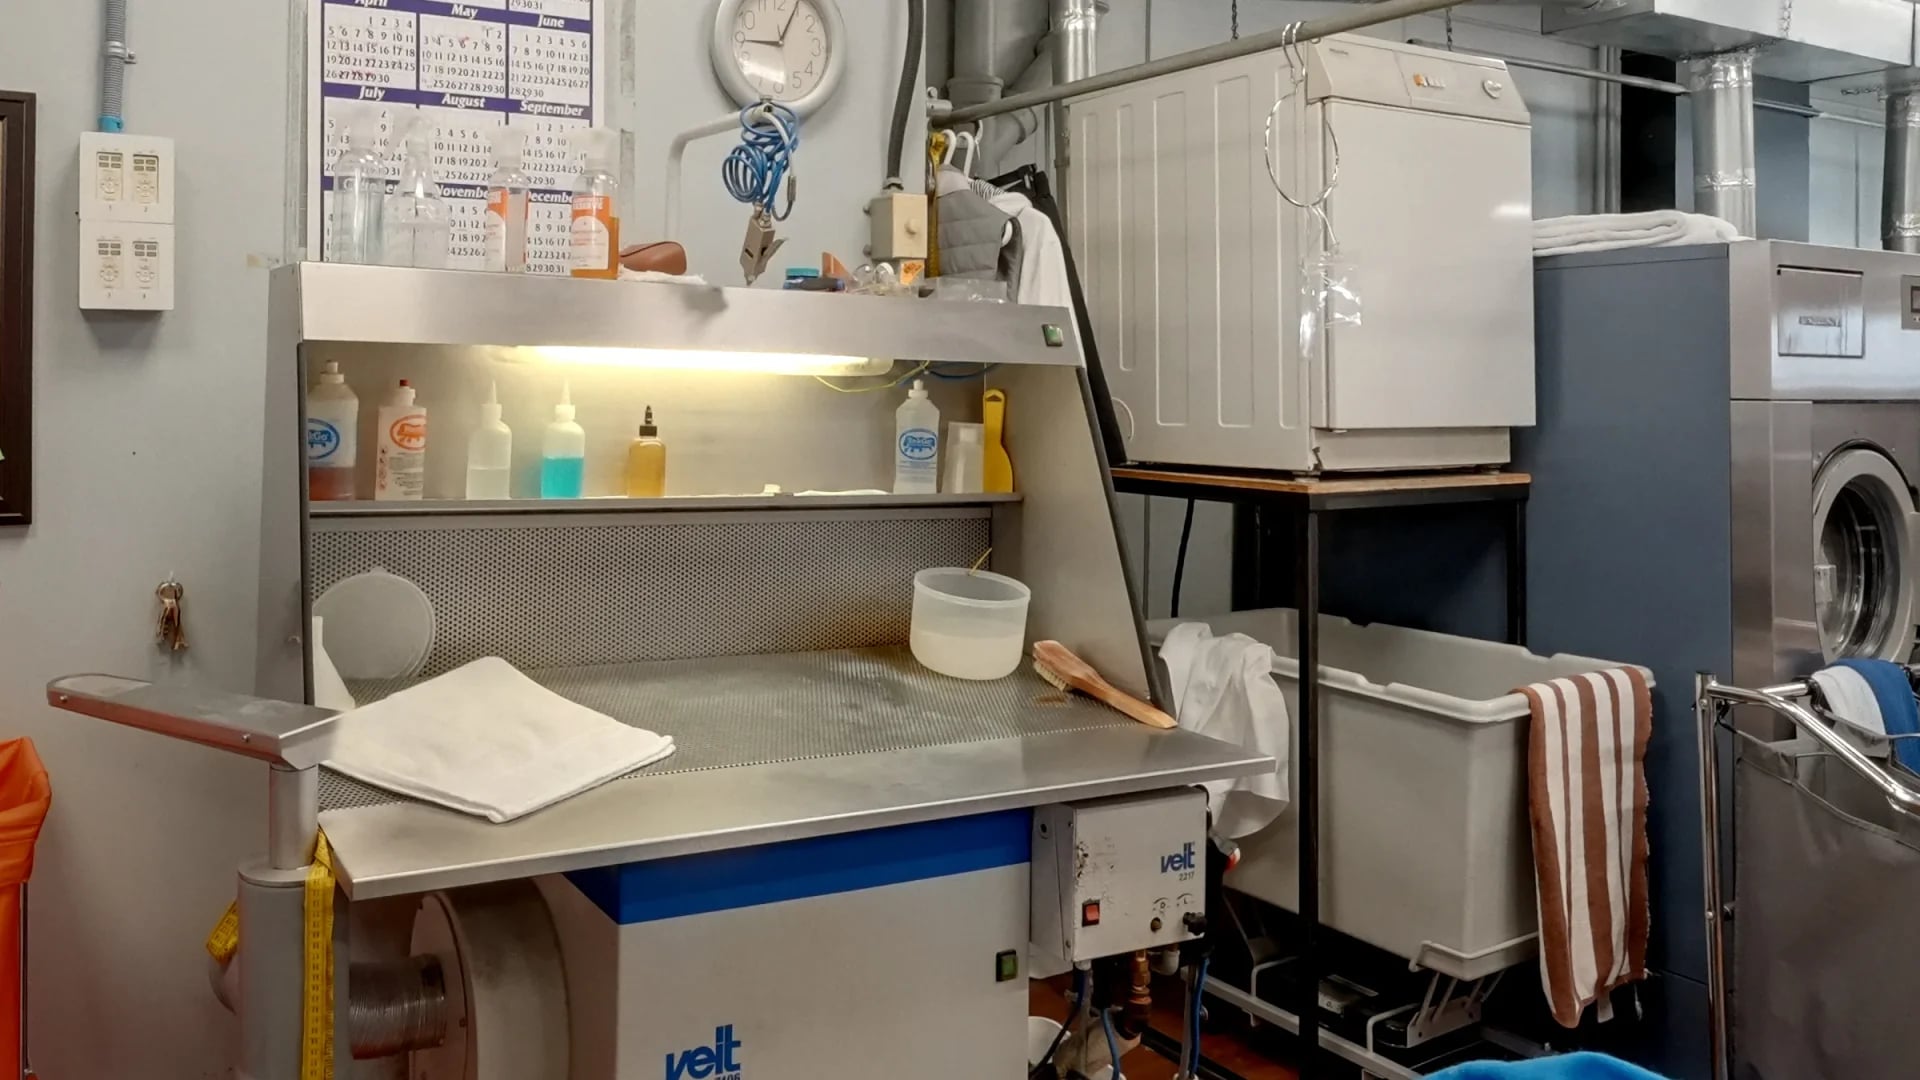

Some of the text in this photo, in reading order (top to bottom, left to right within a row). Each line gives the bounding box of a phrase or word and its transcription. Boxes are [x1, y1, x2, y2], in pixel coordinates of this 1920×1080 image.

[451, 4, 479, 19] May
[381, 17, 386, 26] 2
[395, 19, 399, 28] 3
[407, 20, 412, 28] 4
[537, 14, 565, 28] June
[739, 10, 755, 30] 10
[805, 15, 815, 33] 2
[329, 26, 335, 35] 5
[341, 27, 348, 36] 6
[355, 28, 360, 37] 7
[381, 31, 387, 40] 9
[393, 32, 402, 42] 10
[406, 35, 413, 43] 11
[497, 30, 502, 39] 2
[735, 31, 745, 48] 9
[327, 41, 415, 57] 12 14 15 16 17 18
[424, 36, 429, 44] 3
[449, 39, 454, 47] 5
[473, 42, 478, 50] 7
[536, 35, 541, 43] 2
[547, 36, 553, 45] 3
[570, 39, 576, 48] 5
[581, 41, 587, 49] 6
[811, 38, 821, 57] 3
[435, 52, 442, 60] 11
[447, 53, 456, 61] 12
[459, 54, 468, 63] 13
[471, 56, 480, 64] 14
[483, 57, 493, 65] 15
[496, 58, 504, 66] 16
[513, 46, 518, 55] 7
[524, 47, 530, 56] 8
[546, 50, 555, 58] 10
[558, 51, 565, 60] 11
[569, 53, 578, 61] 12
[327, 55, 415, 71] 19 21 23 25
[523, 61, 532, 70] 15
[534, 63, 544, 71] 16
[557, 64, 567, 73] 18
[805, 61, 812, 76] 4
[326, 70, 390, 83] 26 30
[422, 64, 431, 72] 17
[435, 65, 444, 74] 18
[458, 68, 469, 76] 20
[470, 69, 480, 78] 21
[482, 70, 493, 79] 22
[494, 71, 504, 80] 23
[433, 79, 444, 88] 25
[446, 80, 456, 89] 26
[458, 81, 468, 90] 27
[470, 83, 480, 91] 28
[482, 84, 493, 92] 29
[494, 85, 505, 93] 30
[510, 73, 519, 82] 21
[522, 74, 532, 83] 22
[533, 76, 544, 84] 23
[544, 77, 555, 85] 24
[579, 80, 589, 88] 27
[792, 71, 801, 88] 5
[360, 86, 385, 100] July
[533, 89, 544, 98] 30
[442, 93, 486, 108] August
[520, 100, 584, 116] September
[329, 120, 334, 128] 5
[380, 124, 386, 132] 9
[340, 135, 350, 144] 13
[436, 128, 441, 136] 3
[448, 129, 453, 137] 4
[460, 130, 466, 138] 5
[536, 136, 540, 144] 8
[434, 142, 444, 150] 10
[447, 143, 455, 152] 11
[459, 144, 468, 152] 12
[534, 150, 543, 158] 15
[470, 159, 480, 167] 20
[533, 163, 543, 172] 22
[545, 164, 555, 172] 23
[446, 170, 480, 180] 25 26 27
[546, 177, 555, 185] 30
[472, 206, 478, 215] 5
[546, 224, 552, 232] 9
[459, 234, 468, 242] 18
[534, 237, 543, 245] 15
[458, 248, 480, 256] 25 26
[1160, 842, 1195, 873] veit
[666, 1024, 741, 1080] veit
